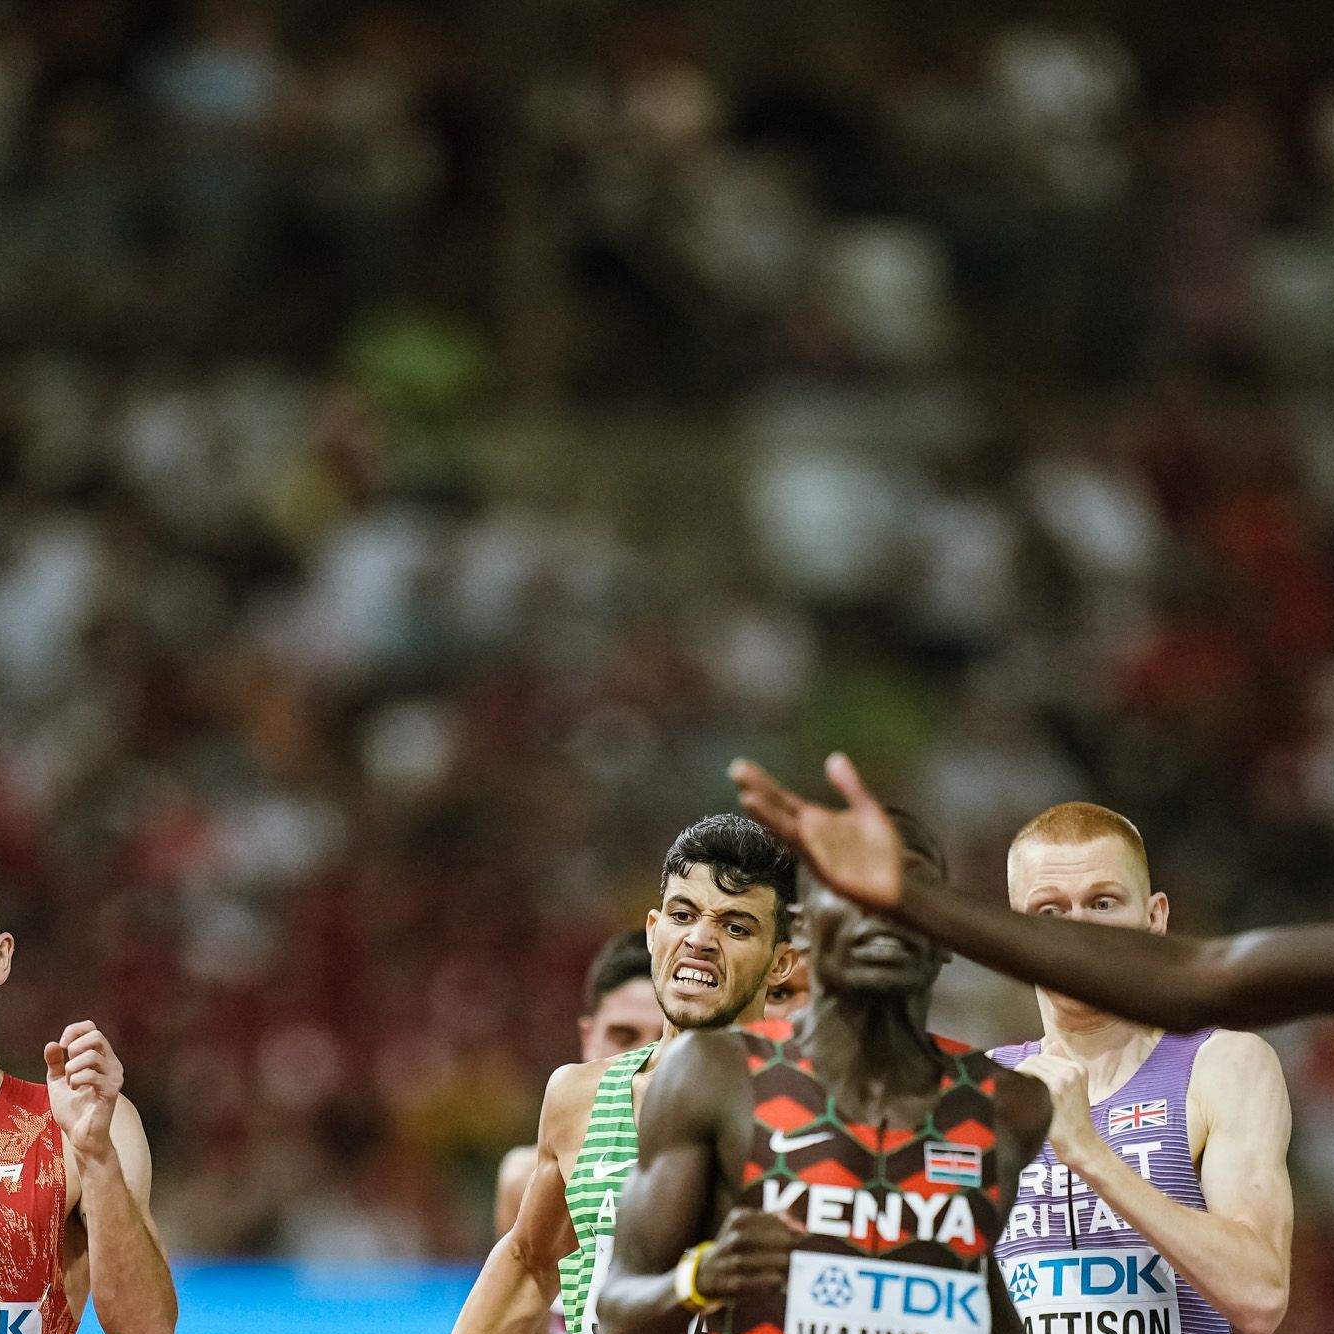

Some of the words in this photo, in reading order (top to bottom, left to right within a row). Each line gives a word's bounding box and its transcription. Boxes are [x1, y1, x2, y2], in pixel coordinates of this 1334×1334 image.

[1019, 1141, 1162, 1197] RET
[762, 1179, 976, 1245] KENYA
[1002, 1198, 1132, 1243] RITA
[858, 1270, 979, 1326] TDK
[1039, 1254, 1168, 1297] TDK
